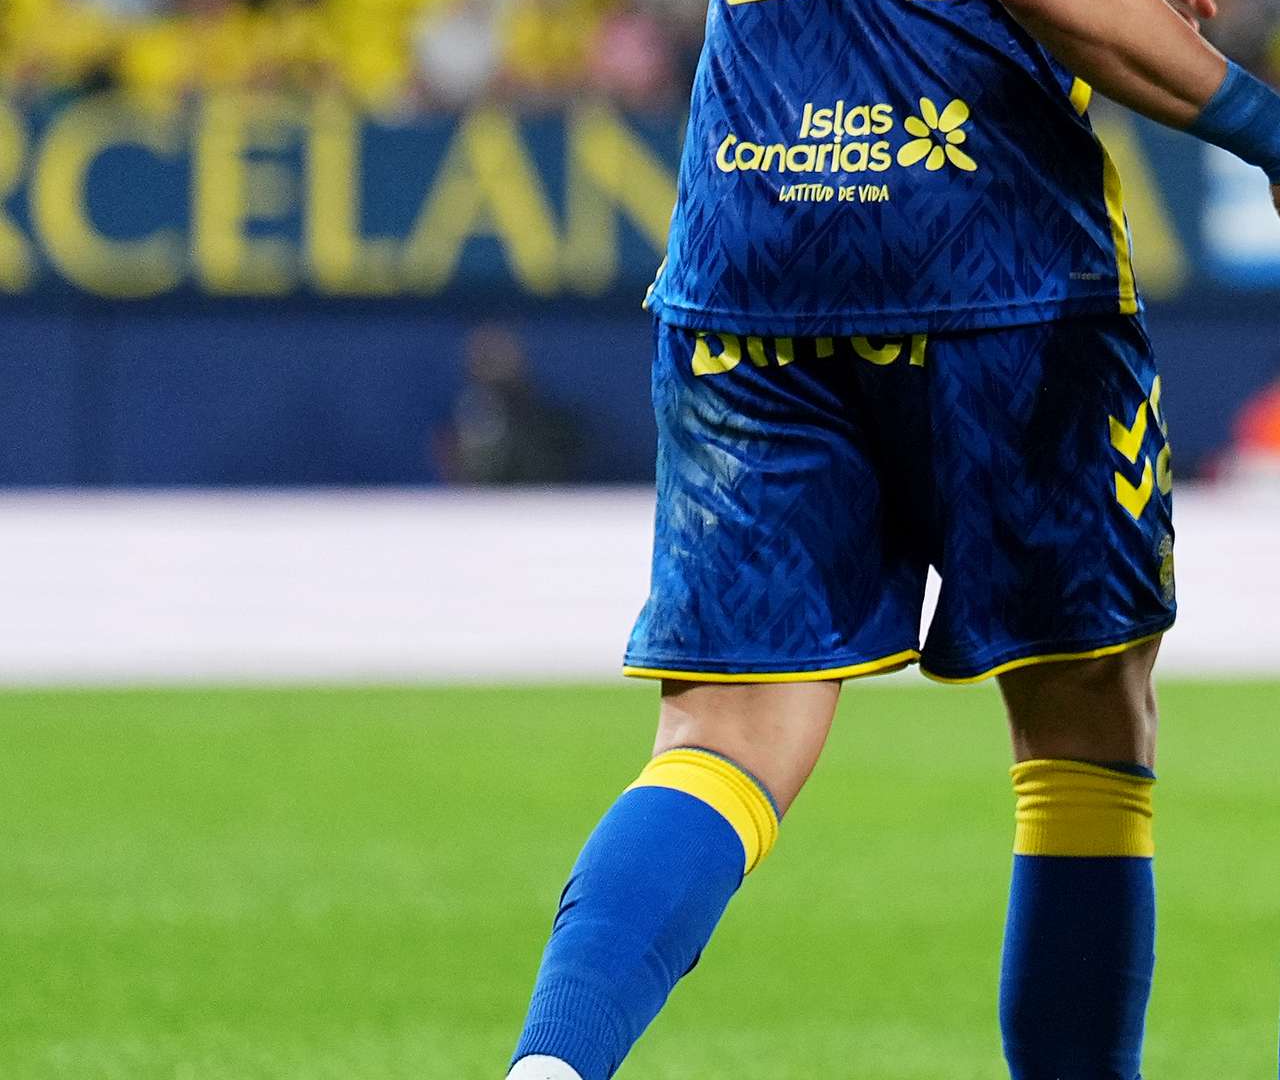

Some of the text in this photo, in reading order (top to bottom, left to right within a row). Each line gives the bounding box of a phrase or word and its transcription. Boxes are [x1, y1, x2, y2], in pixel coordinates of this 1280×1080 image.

[799, 100, 894, 139] Islas
[716, 133, 892, 174] Canarias
[779, 183, 890, 203] LATITUD DE VIDA
